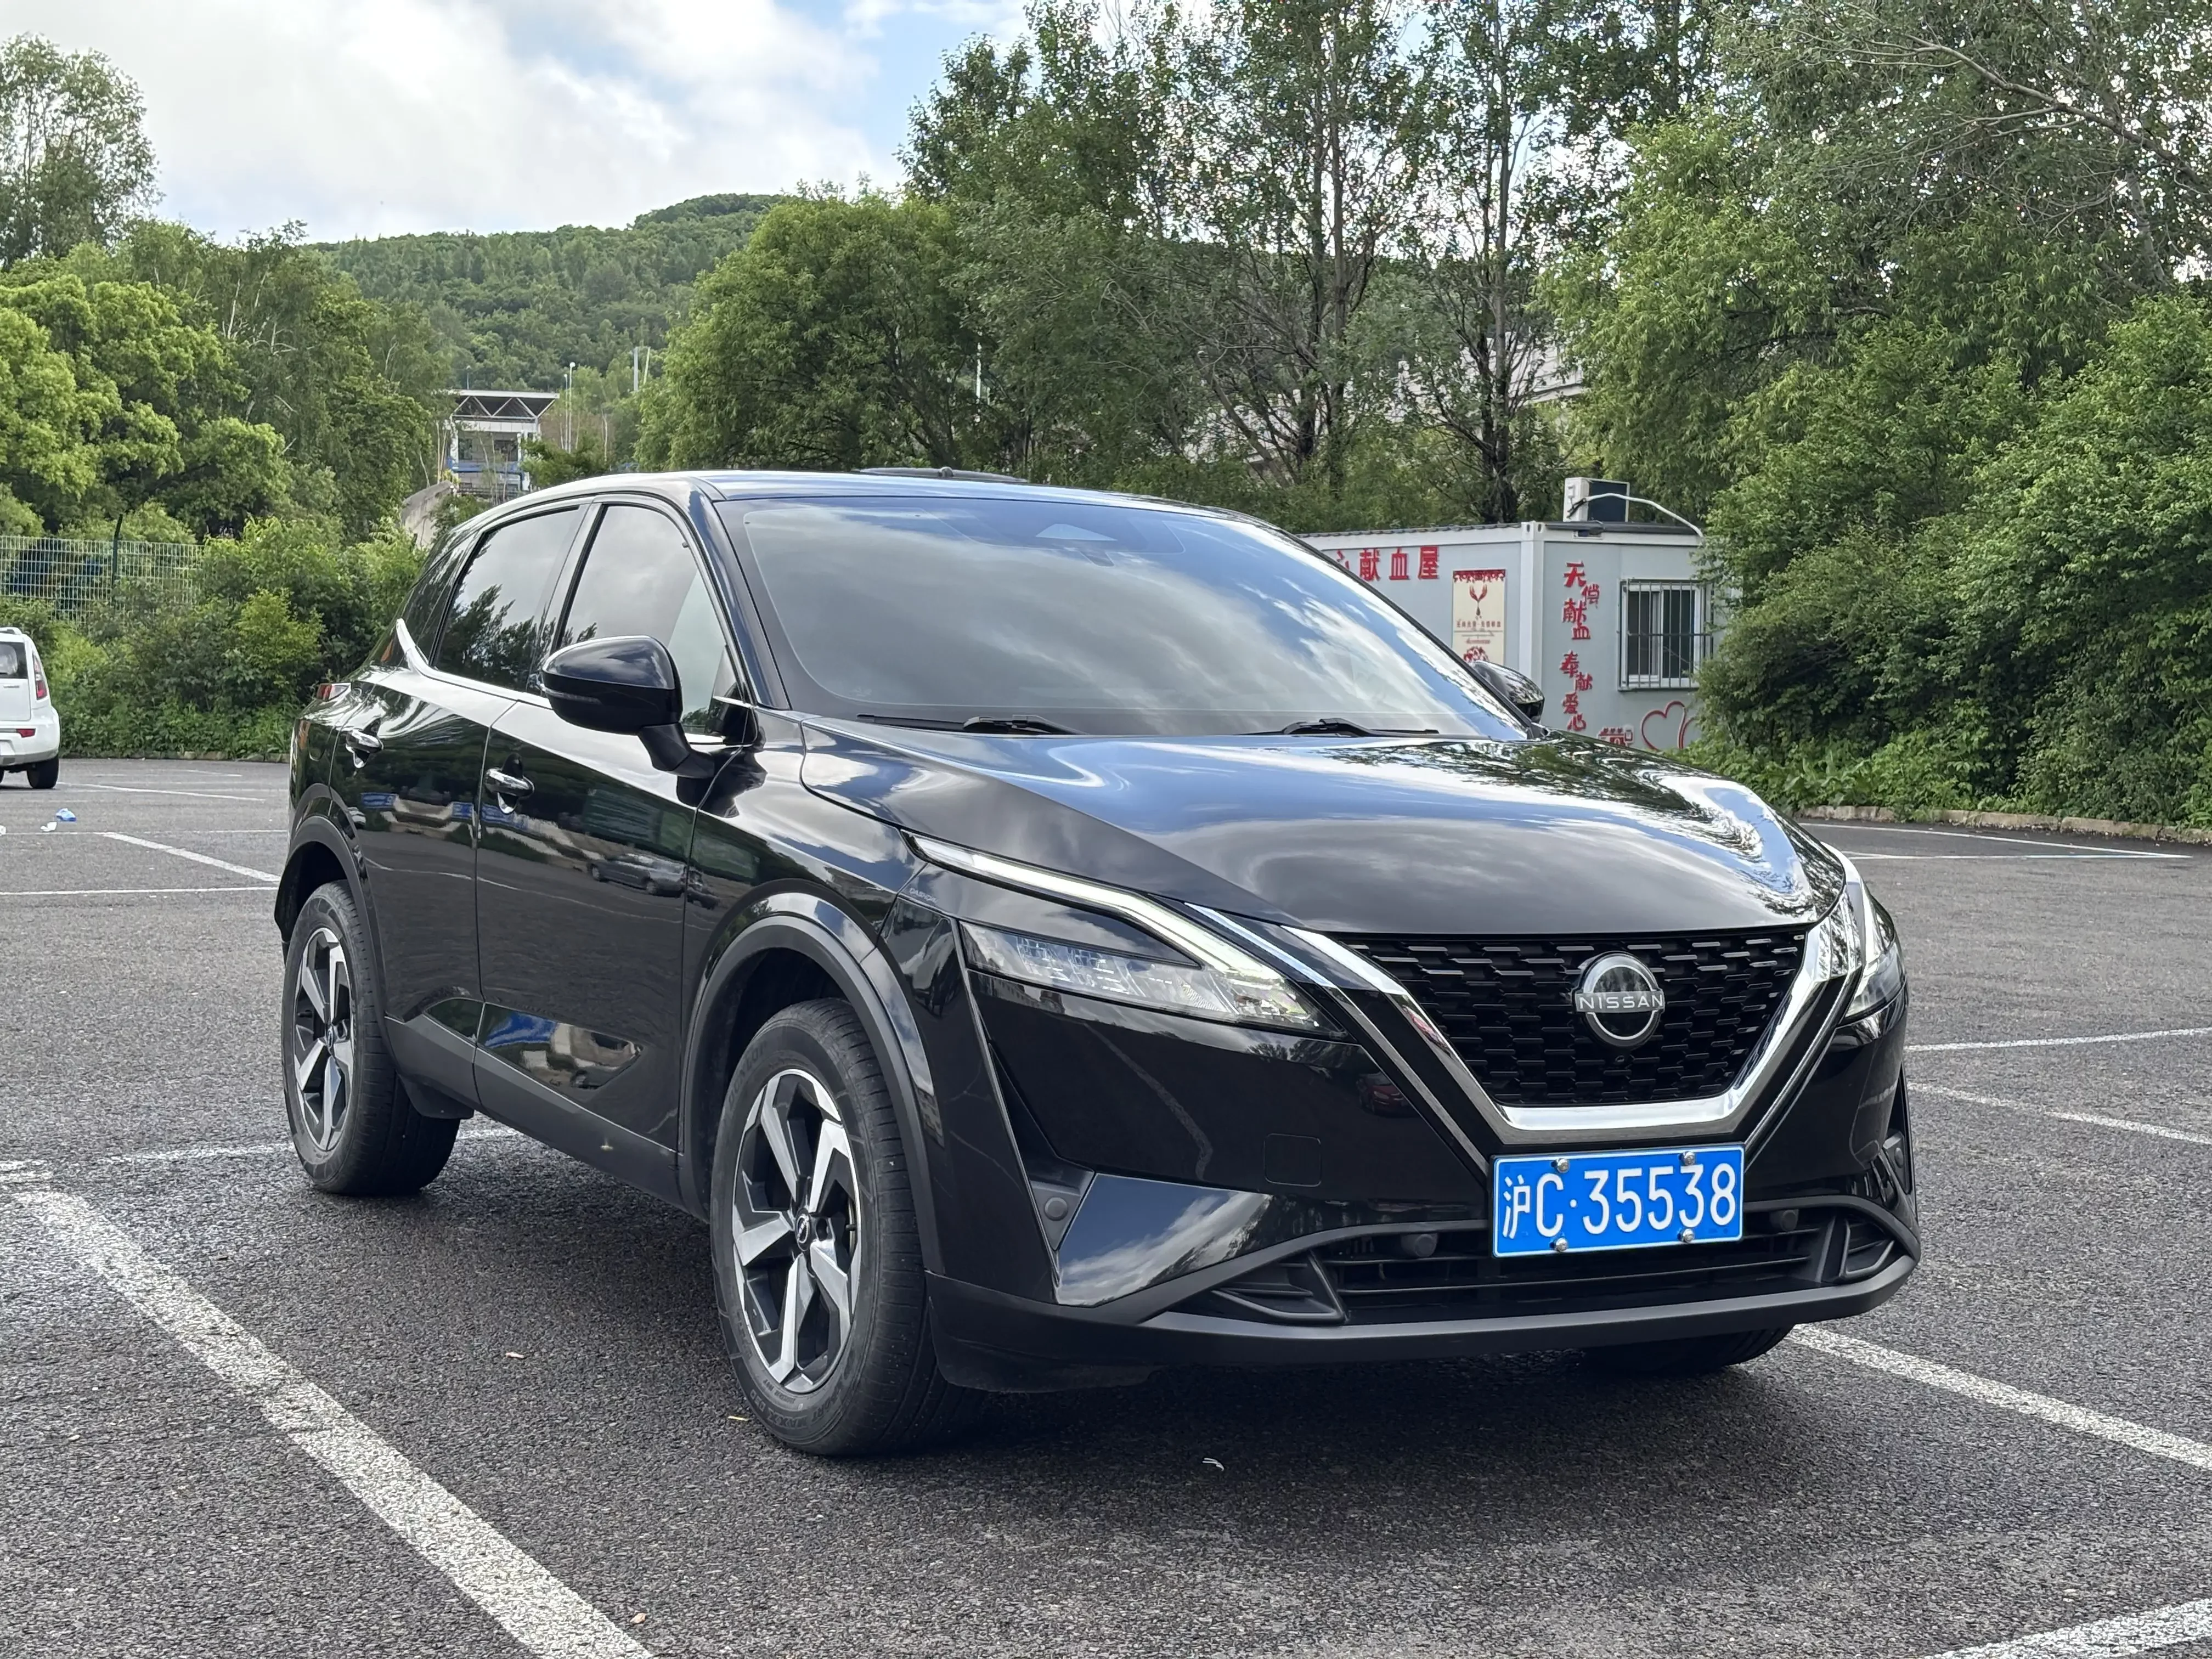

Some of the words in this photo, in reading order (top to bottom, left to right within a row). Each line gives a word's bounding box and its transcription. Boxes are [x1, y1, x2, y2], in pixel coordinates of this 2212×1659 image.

[1559, 650, 1593, 732] 奉献爱心
[1578, 994, 1663, 1009] NISSAN
